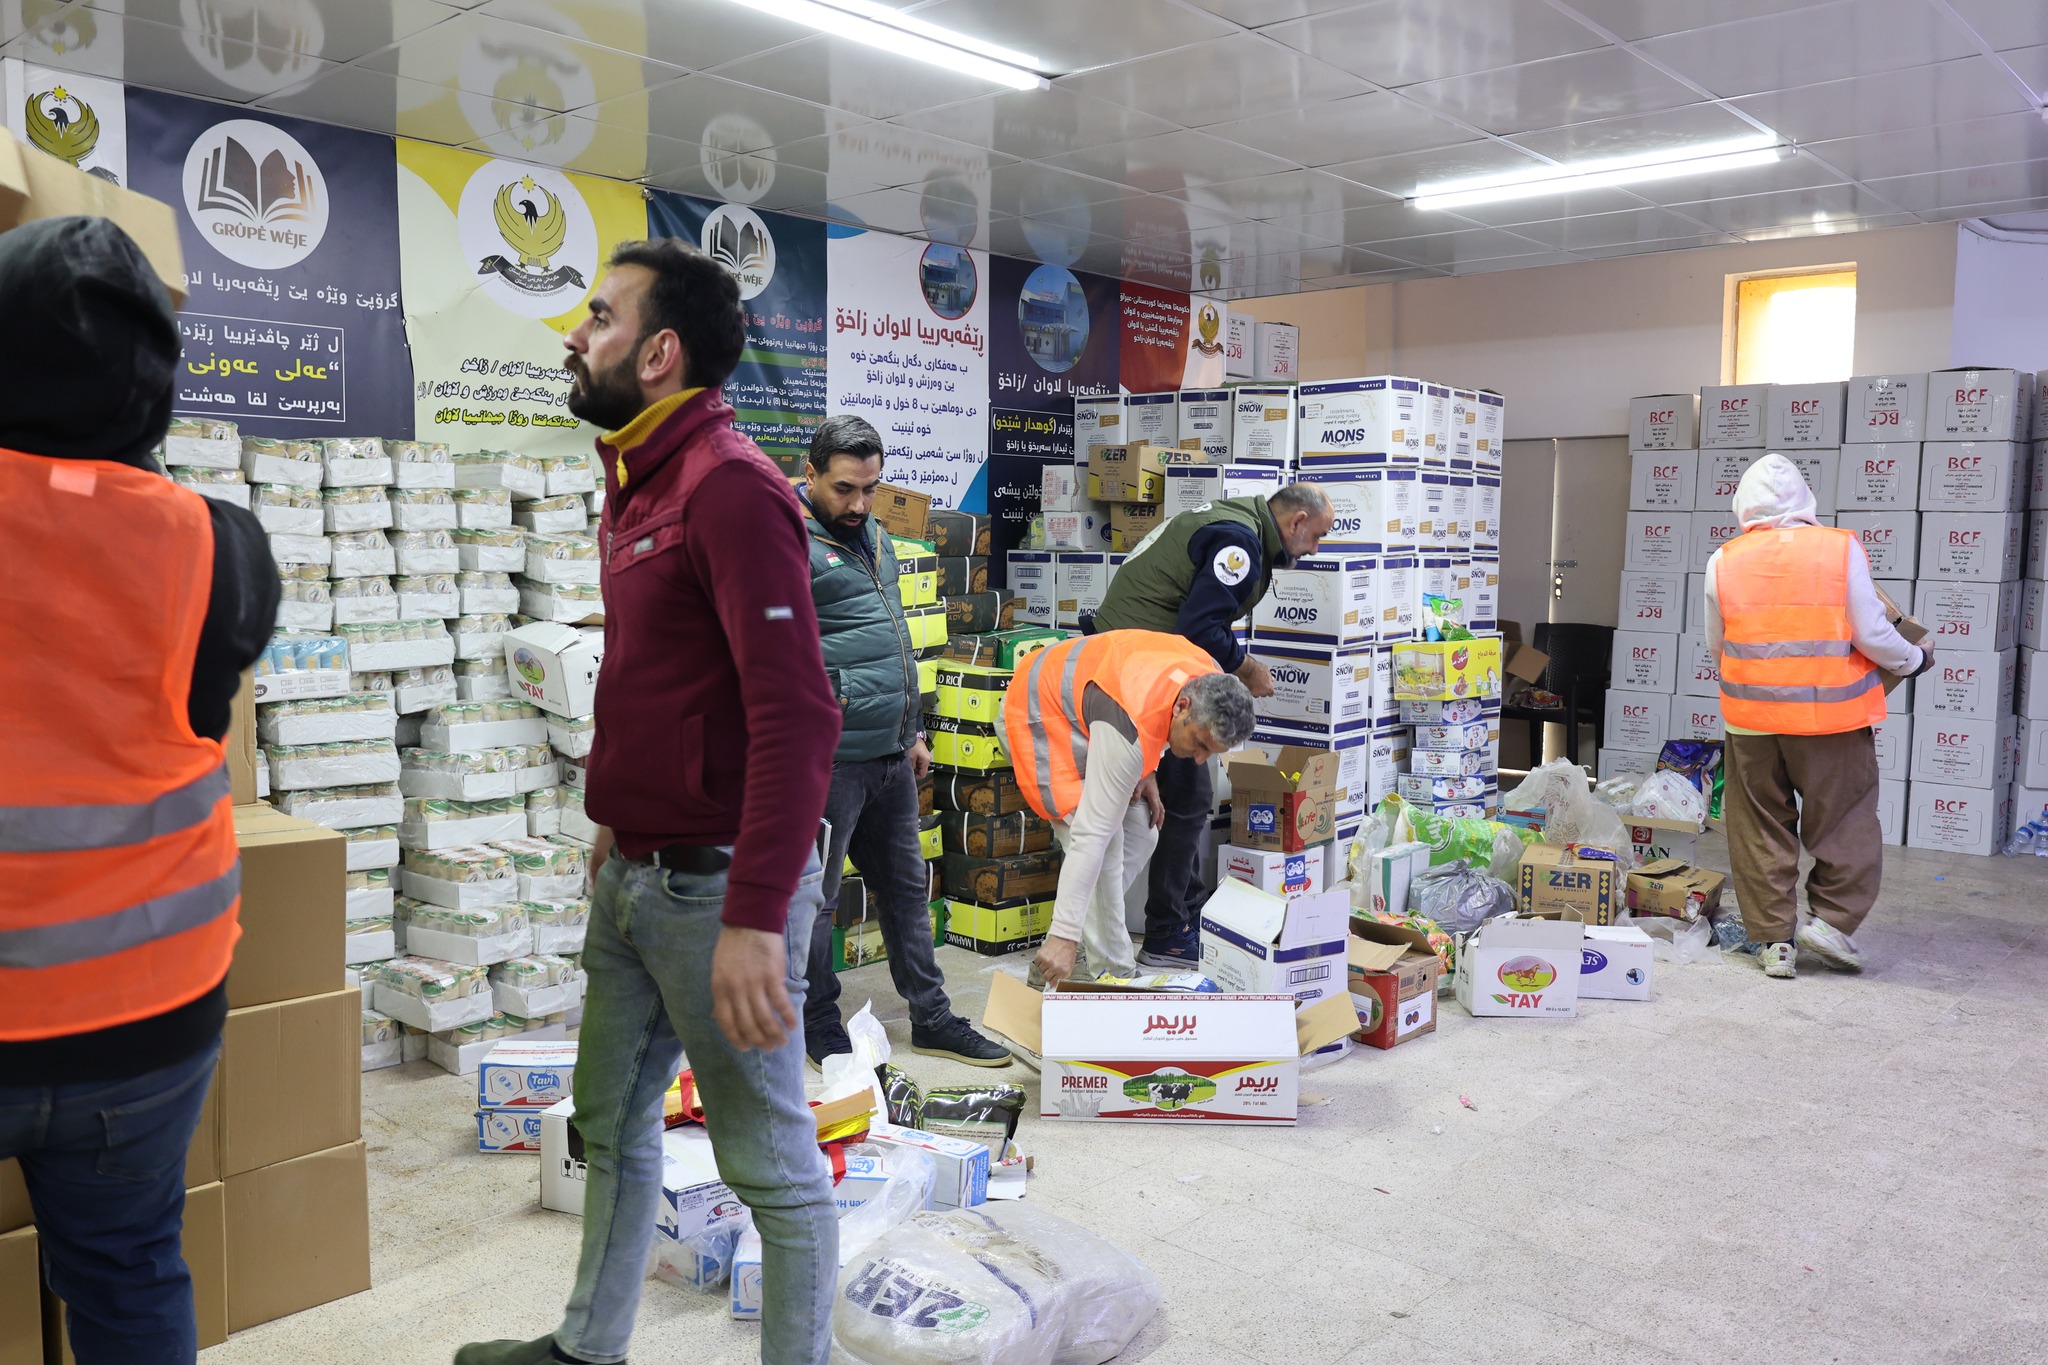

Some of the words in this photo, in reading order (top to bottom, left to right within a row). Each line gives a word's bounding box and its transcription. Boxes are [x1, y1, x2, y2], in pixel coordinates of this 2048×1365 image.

[211, 221, 267, 241] GRÛPÊ
[270, 229, 308, 249] WÊJE
[836, 307, 867, 336] زاخۆ
[873, 314, 911, 341] لاوان
[328, 336, 339, 353] ل
[885, 372, 906, 386] لاوان
[1033, 377, 1062, 395] لاوان
[1955, 388, 1988, 403] BCF
[912, 398, 918, 410] 8
[1238, 404, 1263, 413] SNOW
[1721, 398, 1748, 411] BCF
[1791, 400, 1819, 414] BCF
[1077, 412, 1099, 420] SNOW
[1650, 410, 1674, 423] BCF
[1869, 412, 1899, 426] BCF
[1321, 428, 1365, 443] SNOW
[1106, 449, 1127, 461] ZER
[1865, 460, 1895, 473] BCF
[1948, 457, 1982, 470] BCF
[911, 470, 917, 481] 3
[1653, 466, 1679, 478] BCF
[1130, 505, 1156, 516] ZER
[1332, 518, 1361, 531] SNO
[1645, 526, 1671, 537] BCF
[1710, 526, 1736, 538] BCF
[1862, 529, 1893, 543] BCF
[1949, 531, 1981, 544] BCF
[899, 564, 912, 574] ICE
[1471, 570, 1485, 579] SNOW
[1274, 606, 1318, 621] SNOW
[1632, 647, 1657, 659] BCF
[1269, 668, 1310, 685] SNOW
[1336, 665, 1354, 676] SNOW
[1944, 667, 1975, 682] BCF
[524, 684, 544, 700] TAY
[1623, 705, 1648, 717] BCF
[1691, 713, 1717, 725] BCF
[1937, 732, 1969, 746] BCF
[1373, 748, 1391, 757] SNOW
[1935, 799, 1967, 813] BCF
[1549, 870, 1592, 889] ZER
[1650, 881, 1664, 891] ZER
[1508, 994, 1543, 1008] TAY
[1143, 1014, 1197, 1035] بريمر
[531, 1074, 554, 1086] Tavi
[1062, 1076, 1107, 1088] PREMER
[1235, 1077, 1278, 1092] بريمر
[846, 1260, 966, 1328] ZER
